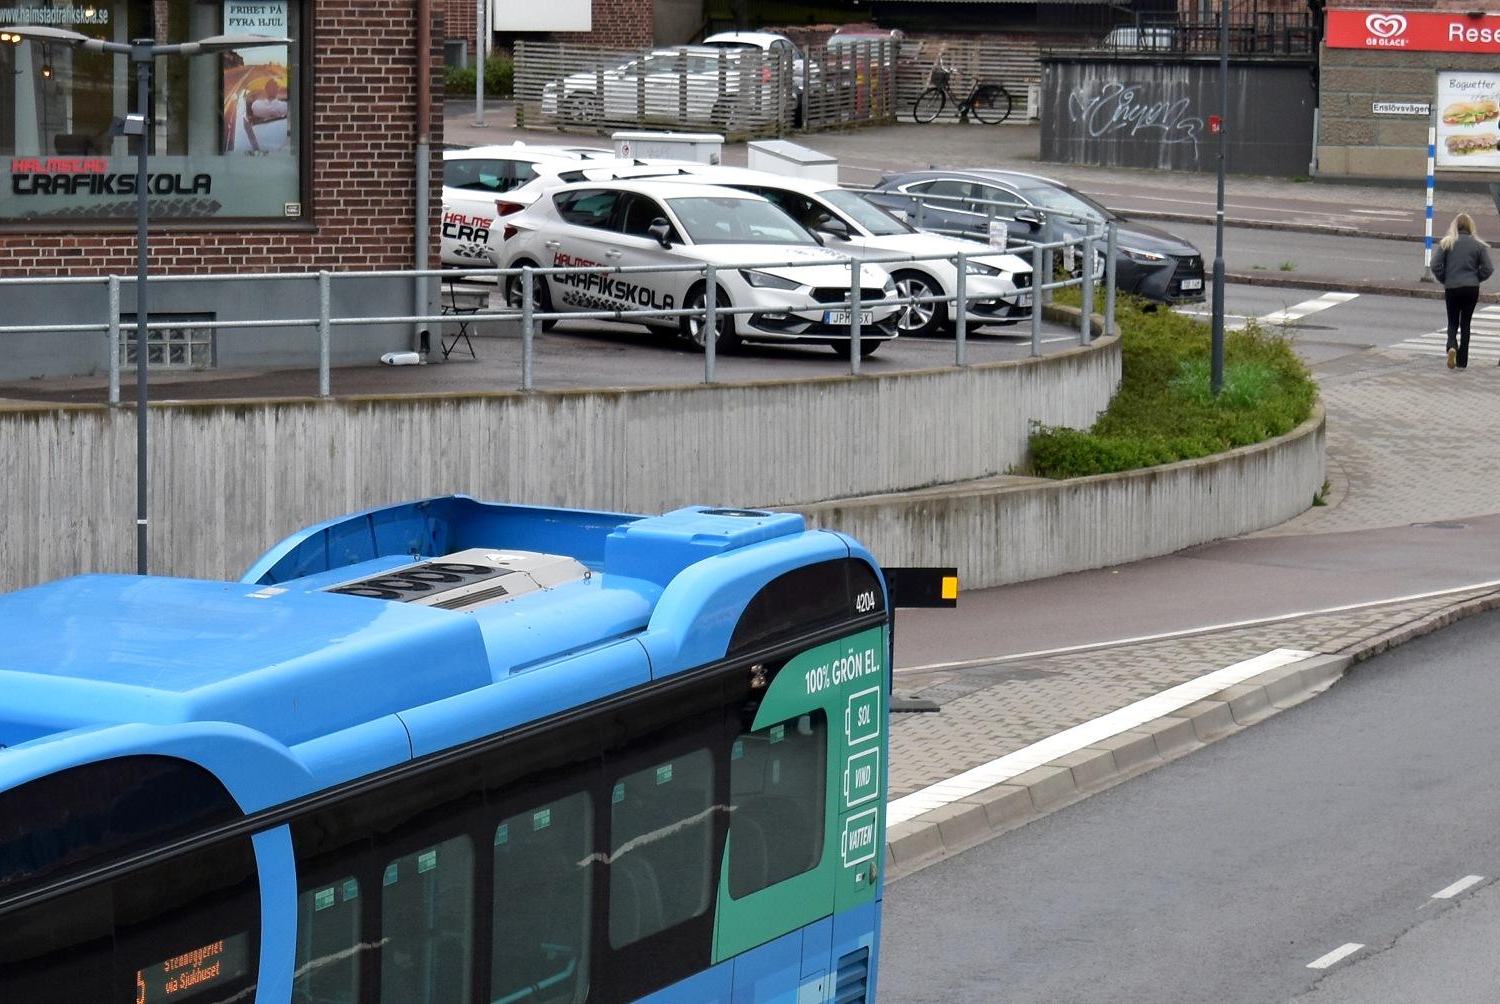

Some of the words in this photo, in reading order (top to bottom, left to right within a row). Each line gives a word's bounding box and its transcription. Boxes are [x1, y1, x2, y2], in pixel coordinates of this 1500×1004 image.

[230, 6, 265, 14] FRIHET
[270, 5, 282, 14] PÅ
[229, 18, 255, 26] FYRA
[259, 18, 283, 26] HJUL
[1449, 79, 1495, 91] Baguetter
[1374, 104, 1429, 114] Enslövsvägen
[856, 591, 875, 612] 4204
[805, 664, 830, 694] 100%
[832, 648, 862, 685] GRÖN
[865, 649, 880, 674] EL.
[857, 704, 870, 726] SOL
[855, 765, 871, 788] VIND
[849, 823, 872, 850] VATTEN
[165, 977, 178, 993] via
[180, 960, 220, 989] Sjukhuset
